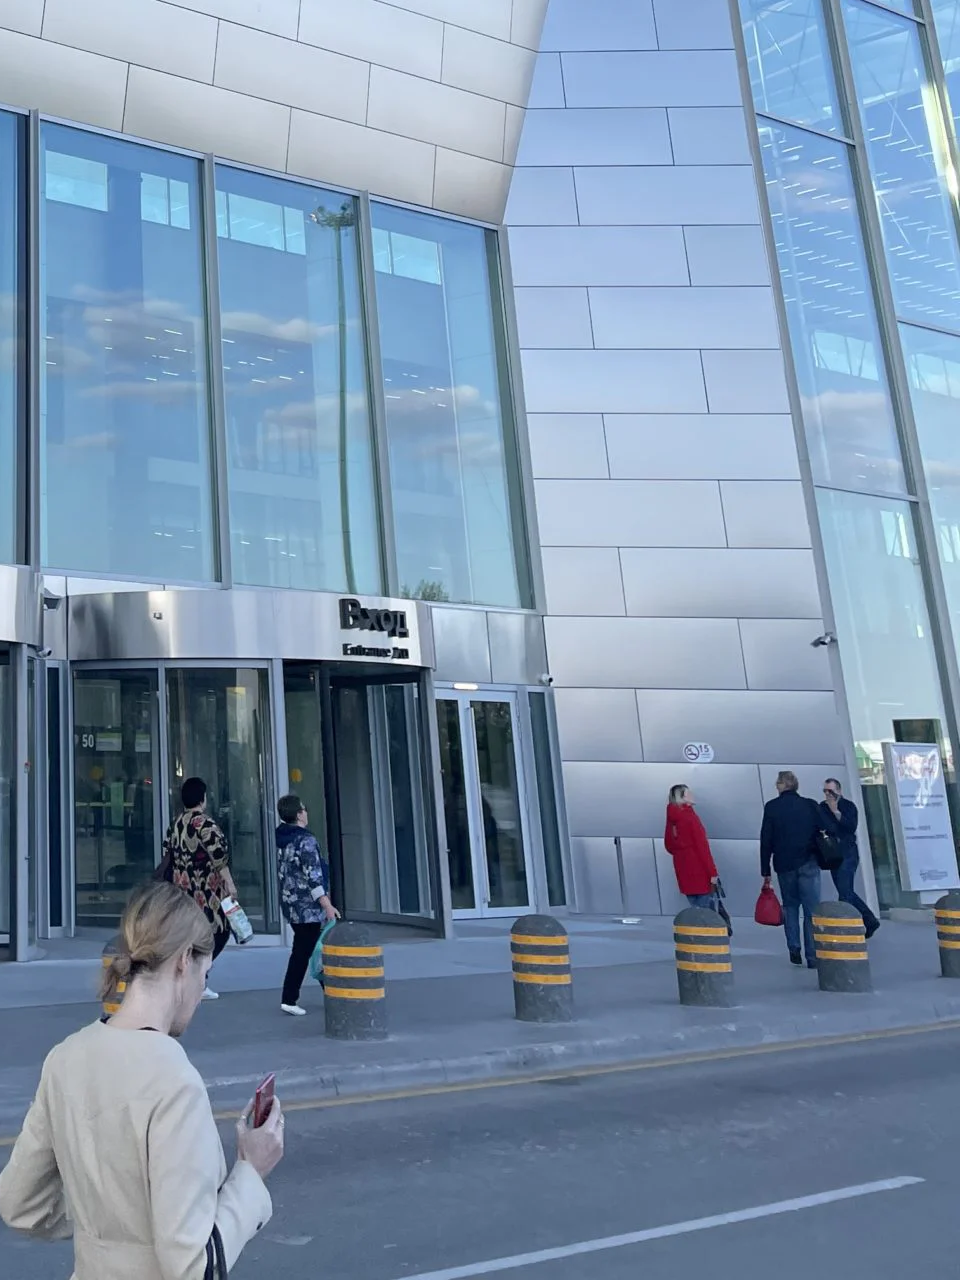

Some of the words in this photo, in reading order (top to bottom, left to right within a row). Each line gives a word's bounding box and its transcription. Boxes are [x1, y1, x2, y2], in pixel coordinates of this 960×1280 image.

[339, 598, 410, 638] Вход
[82, 734, 95, 748] 50
[699, 744, 710, 753] 15
